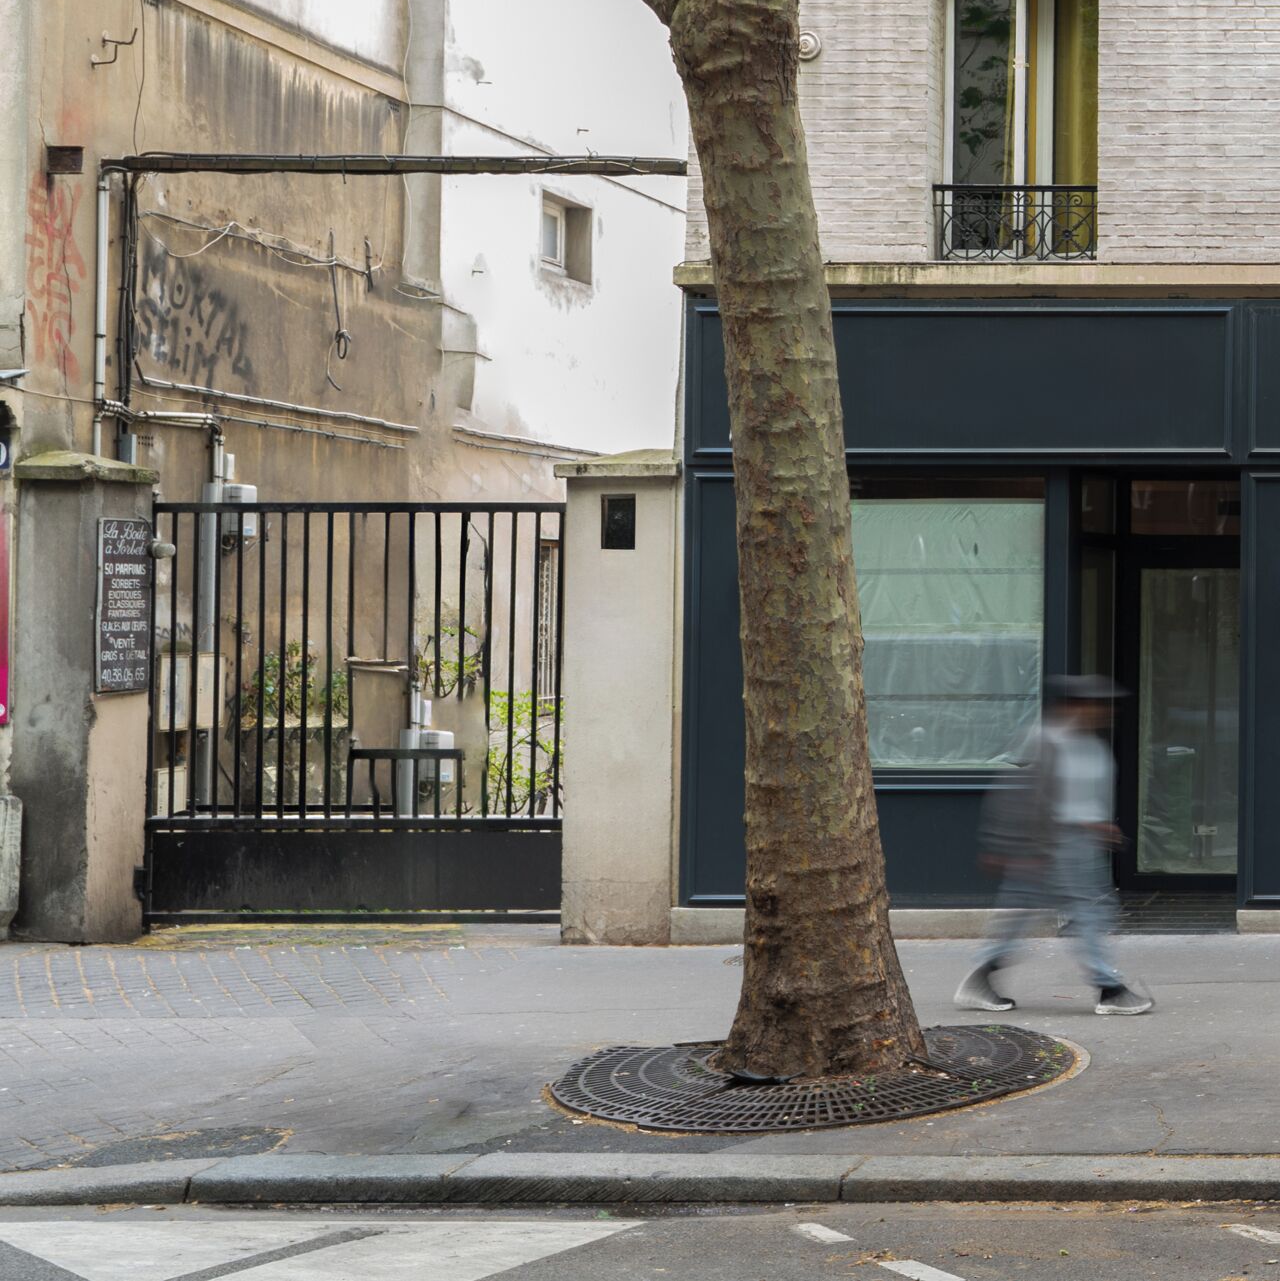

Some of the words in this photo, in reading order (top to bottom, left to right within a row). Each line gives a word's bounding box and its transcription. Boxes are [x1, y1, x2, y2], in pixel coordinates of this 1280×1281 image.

[103, 521, 119, 539] La
[104, 563, 114, 575] 50
[115, 563, 147, 576] PARFUMS
[111, 578, 141, 589] SORBETS
[108, 590, 142, 600] EXOTIQUES
[108, 600, 146, 609] CLASSIQUES
[107, 609, 141, 618] FANTAISIES
[113, 638, 136, 649] VENTE
[101, 650, 118, 661] GROS
